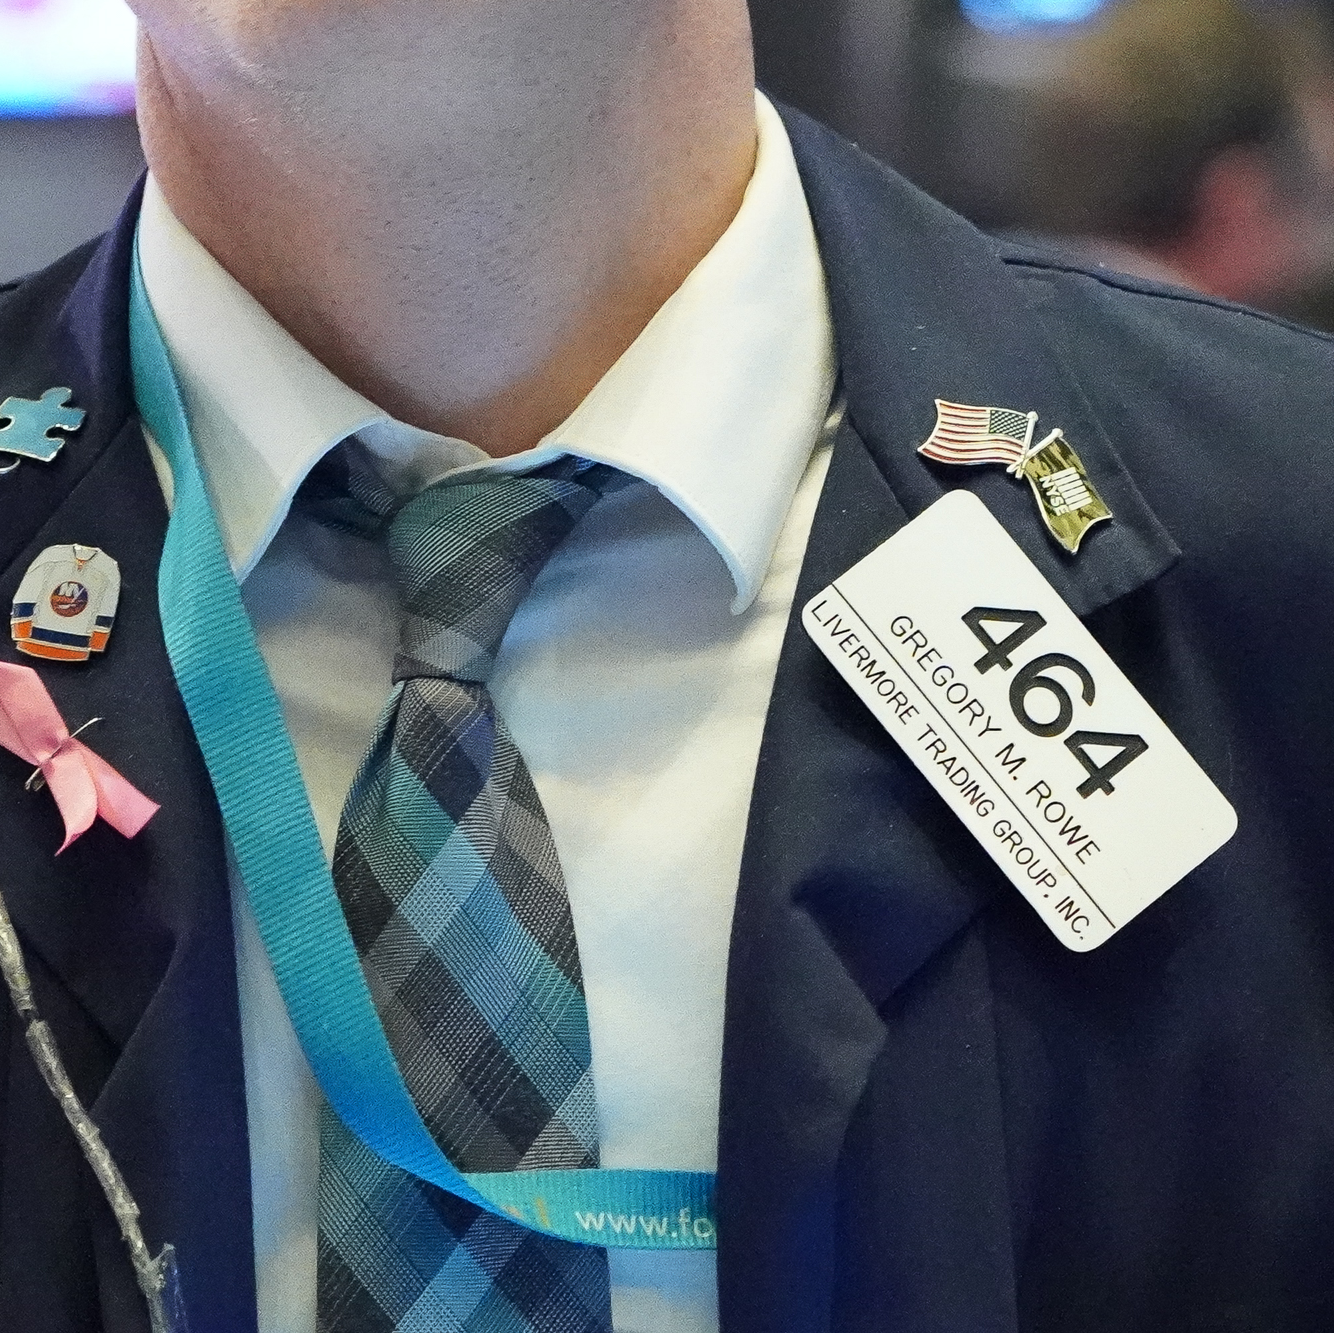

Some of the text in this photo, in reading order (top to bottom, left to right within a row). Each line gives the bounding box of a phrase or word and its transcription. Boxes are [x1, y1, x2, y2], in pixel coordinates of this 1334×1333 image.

[1039, 475, 1069, 517] NYSE
[812, 599, 920, 726] LIVERMORE
[917, 723, 995, 818] TRADING
[1055, 896, 1090, 941] INC.
[890, 615, 1101, 865] GREGORY M. ROWE
[961, 607, 1149, 799] 464
